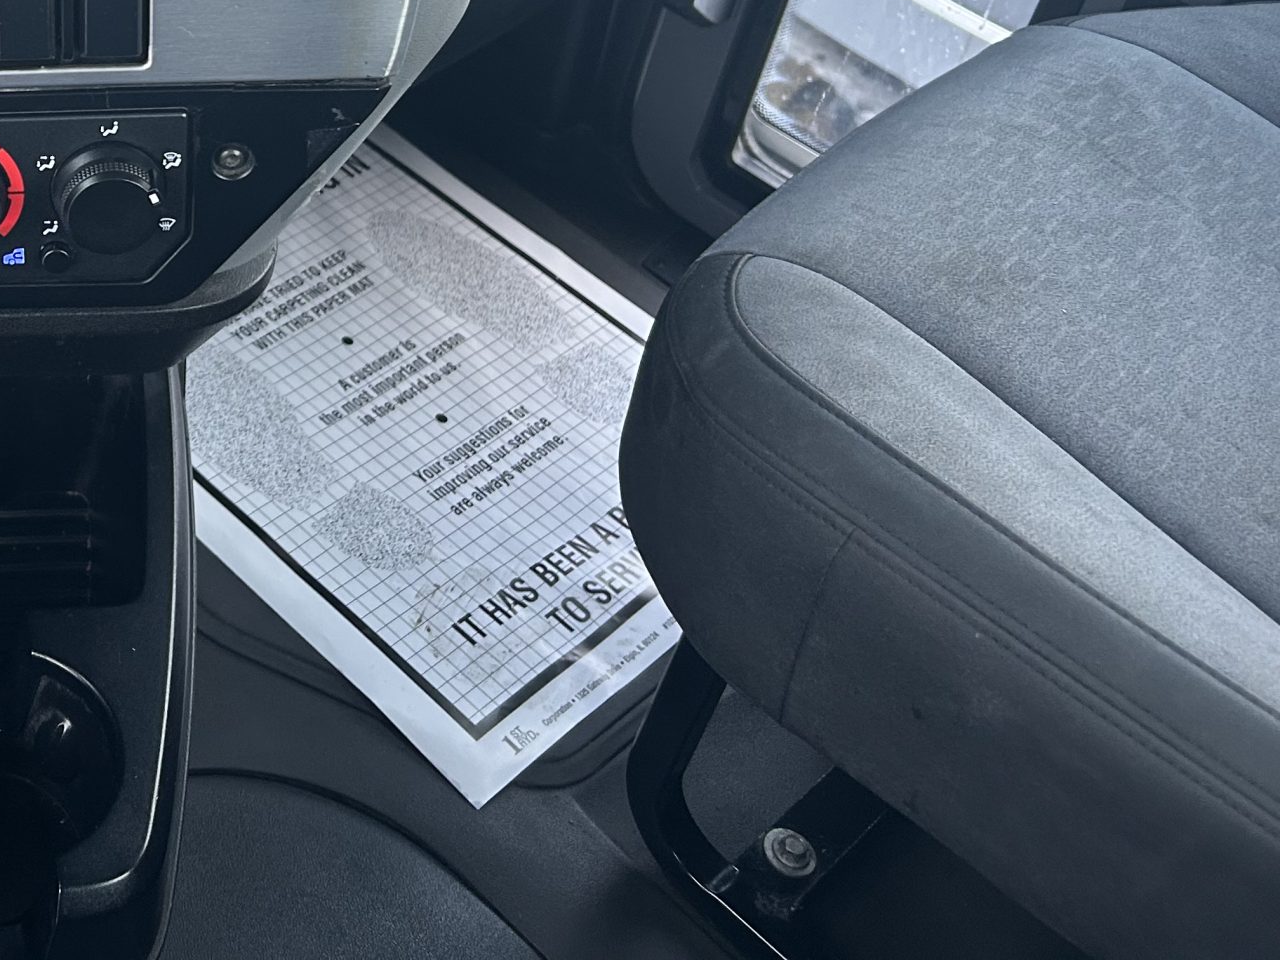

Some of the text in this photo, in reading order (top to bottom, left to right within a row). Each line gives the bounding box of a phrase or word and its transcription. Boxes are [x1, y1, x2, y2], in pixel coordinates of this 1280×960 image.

[231, 260, 367, 340] YOUR CARPETING CLEAN
[252, 275, 375, 350] WITH THIS PAPER MAT
[270, 273, 305, 300] TRIED
[301, 265, 321, 281] TO
[318, 248, 348, 271] KEEP
[319, 332, 466, 426] the most important person
[338, 340, 417, 391] A customer is
[357, 362, 462, 426] in the world to us.
[413, 405, 530, 483] Your suggestions for
[427, 416, 552, 501] improving our service
[450, 434, 569, 515] are always welcome.
[451, 613, 487, 646] IT
[478, 576, 539, 626] HAS
[529, 534, 600, 588] BEEN
[590, 522, 620, 545] A
[545, 596, 591, 633] TO
